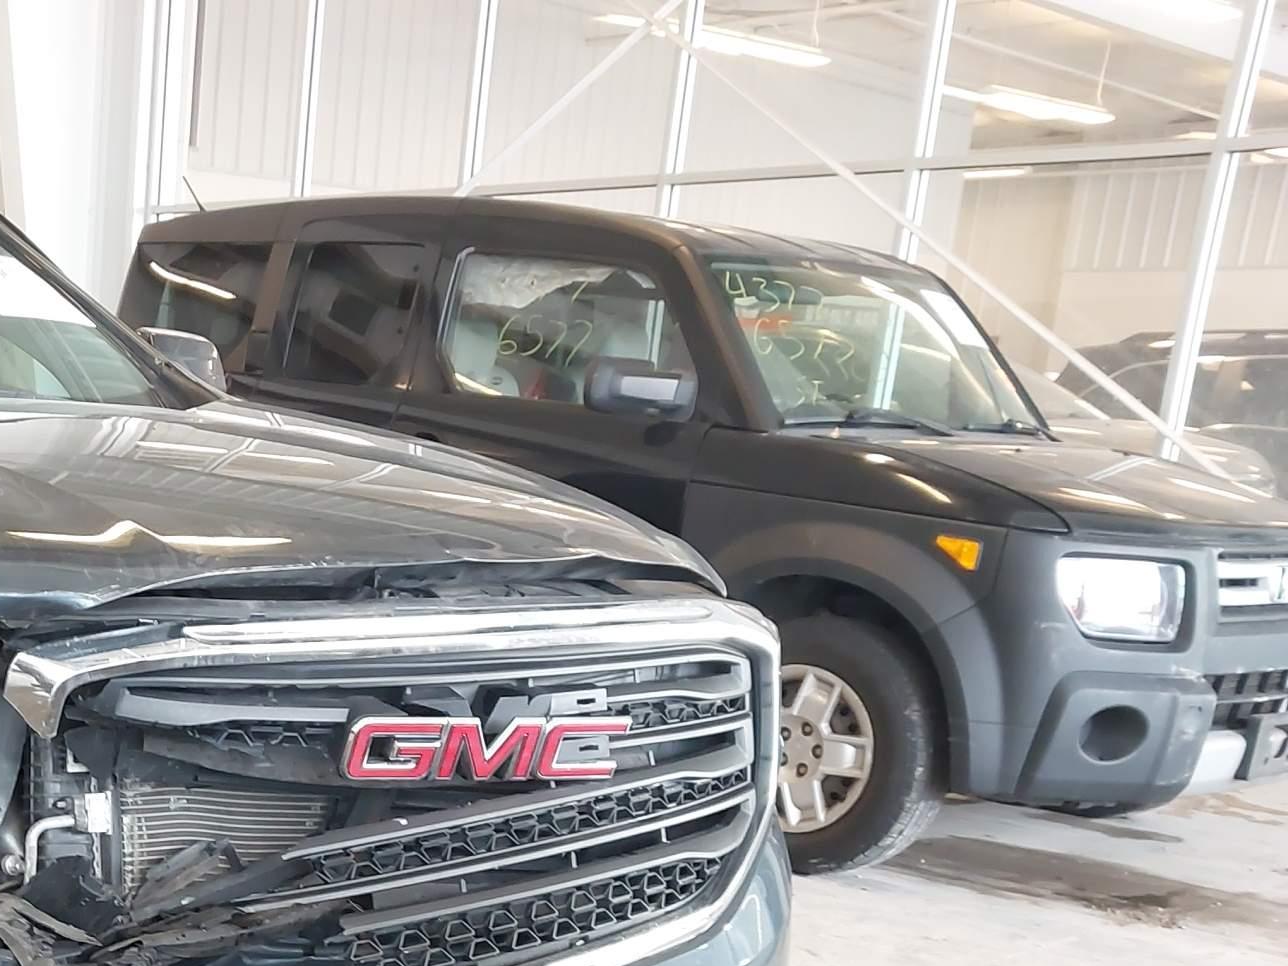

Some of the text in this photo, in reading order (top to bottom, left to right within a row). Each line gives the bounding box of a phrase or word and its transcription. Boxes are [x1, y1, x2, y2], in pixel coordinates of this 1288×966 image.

[725, 270, 824, 322] 4377
[497, 314, 593, 368] 6577
[339, 715, 633, 780] GMC
